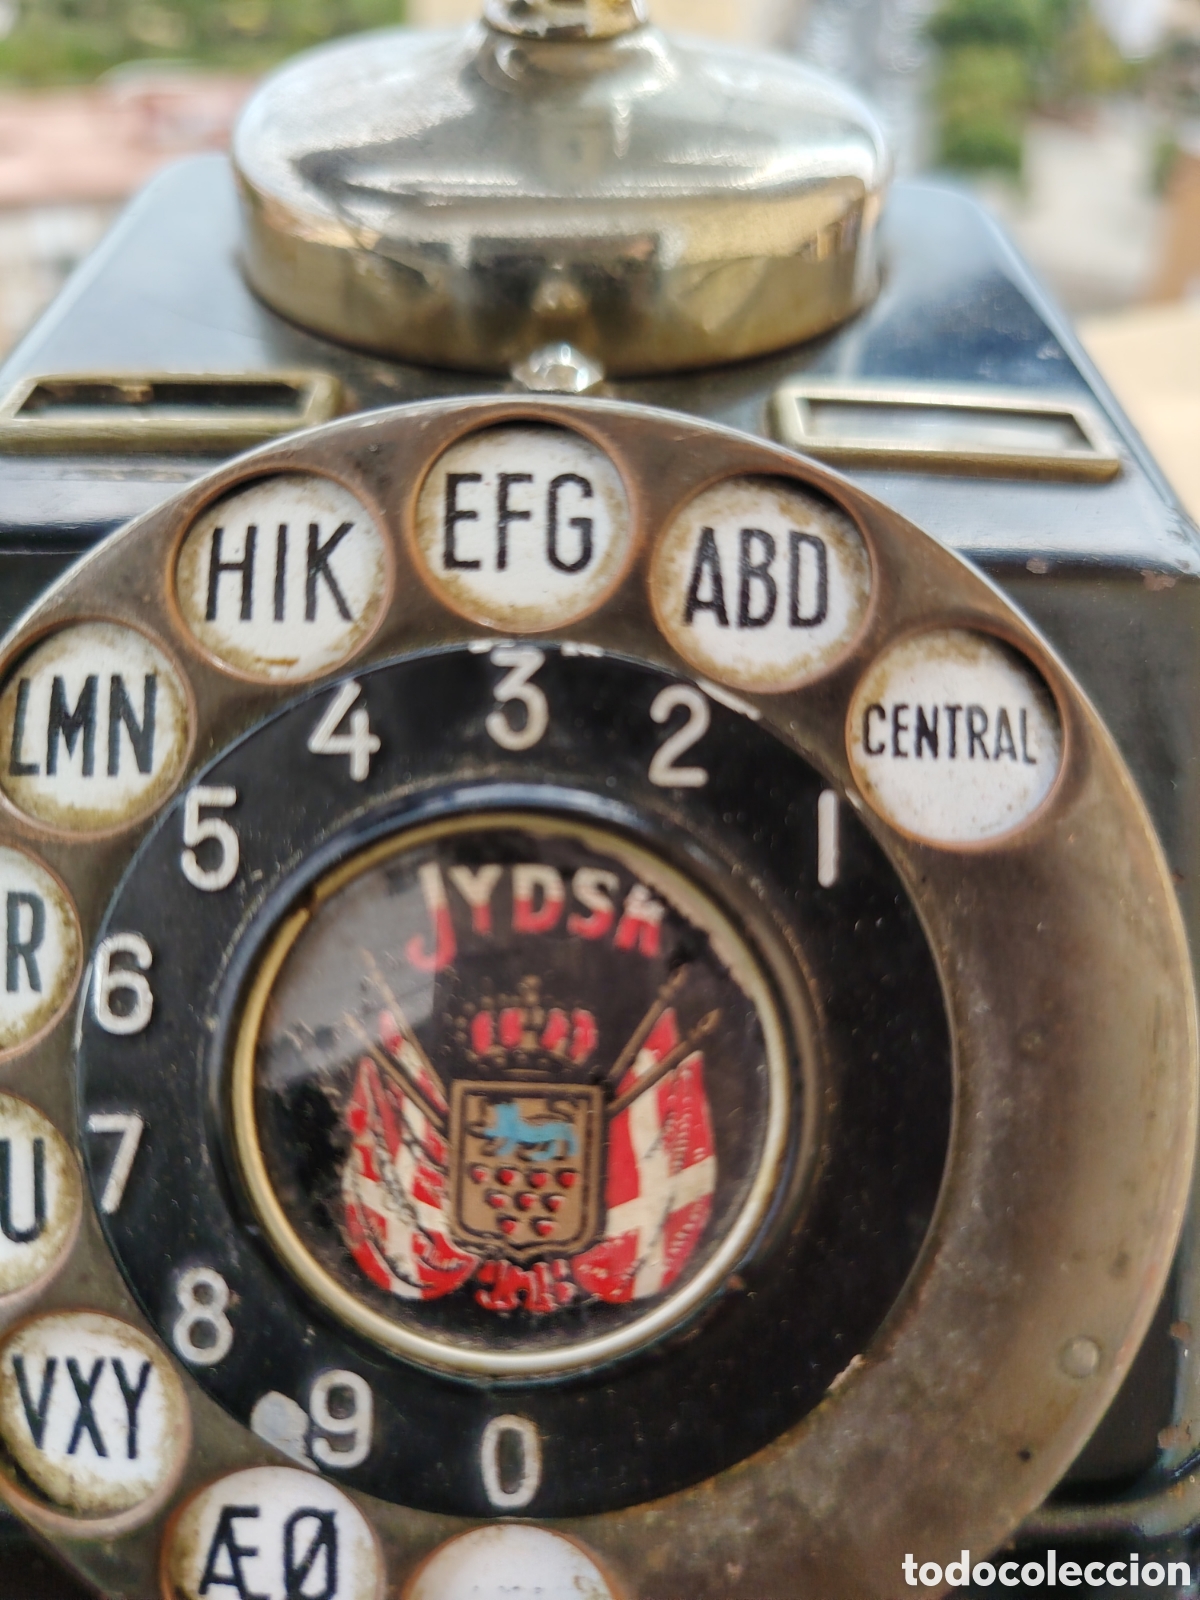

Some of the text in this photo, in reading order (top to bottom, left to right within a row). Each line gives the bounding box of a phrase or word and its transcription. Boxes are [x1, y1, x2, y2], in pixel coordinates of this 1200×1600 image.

[205, 520, 356, 623] HIK
[443, 471, 594, 575] EFG
[682, 526, 830, 630] ABD
[8, 674, 157, 777] LMN
[308, 678, 381, 782] 4
[485, 645, 549, 751] 3
[648, 684, 710, 788] 2
[861, 703, 1038, 765] CENTRAL
[180, 785, 240, 892] 5
[95, 932, 153, 1036] 6
[88, 1113, 145, 1215] 7
[173, 1266, 234, 1366] 8
[12, 1353, 154, 1461] VXY
[309, 1368, 374, 1469] 9
[481, 1413, 543, 1509] 0
